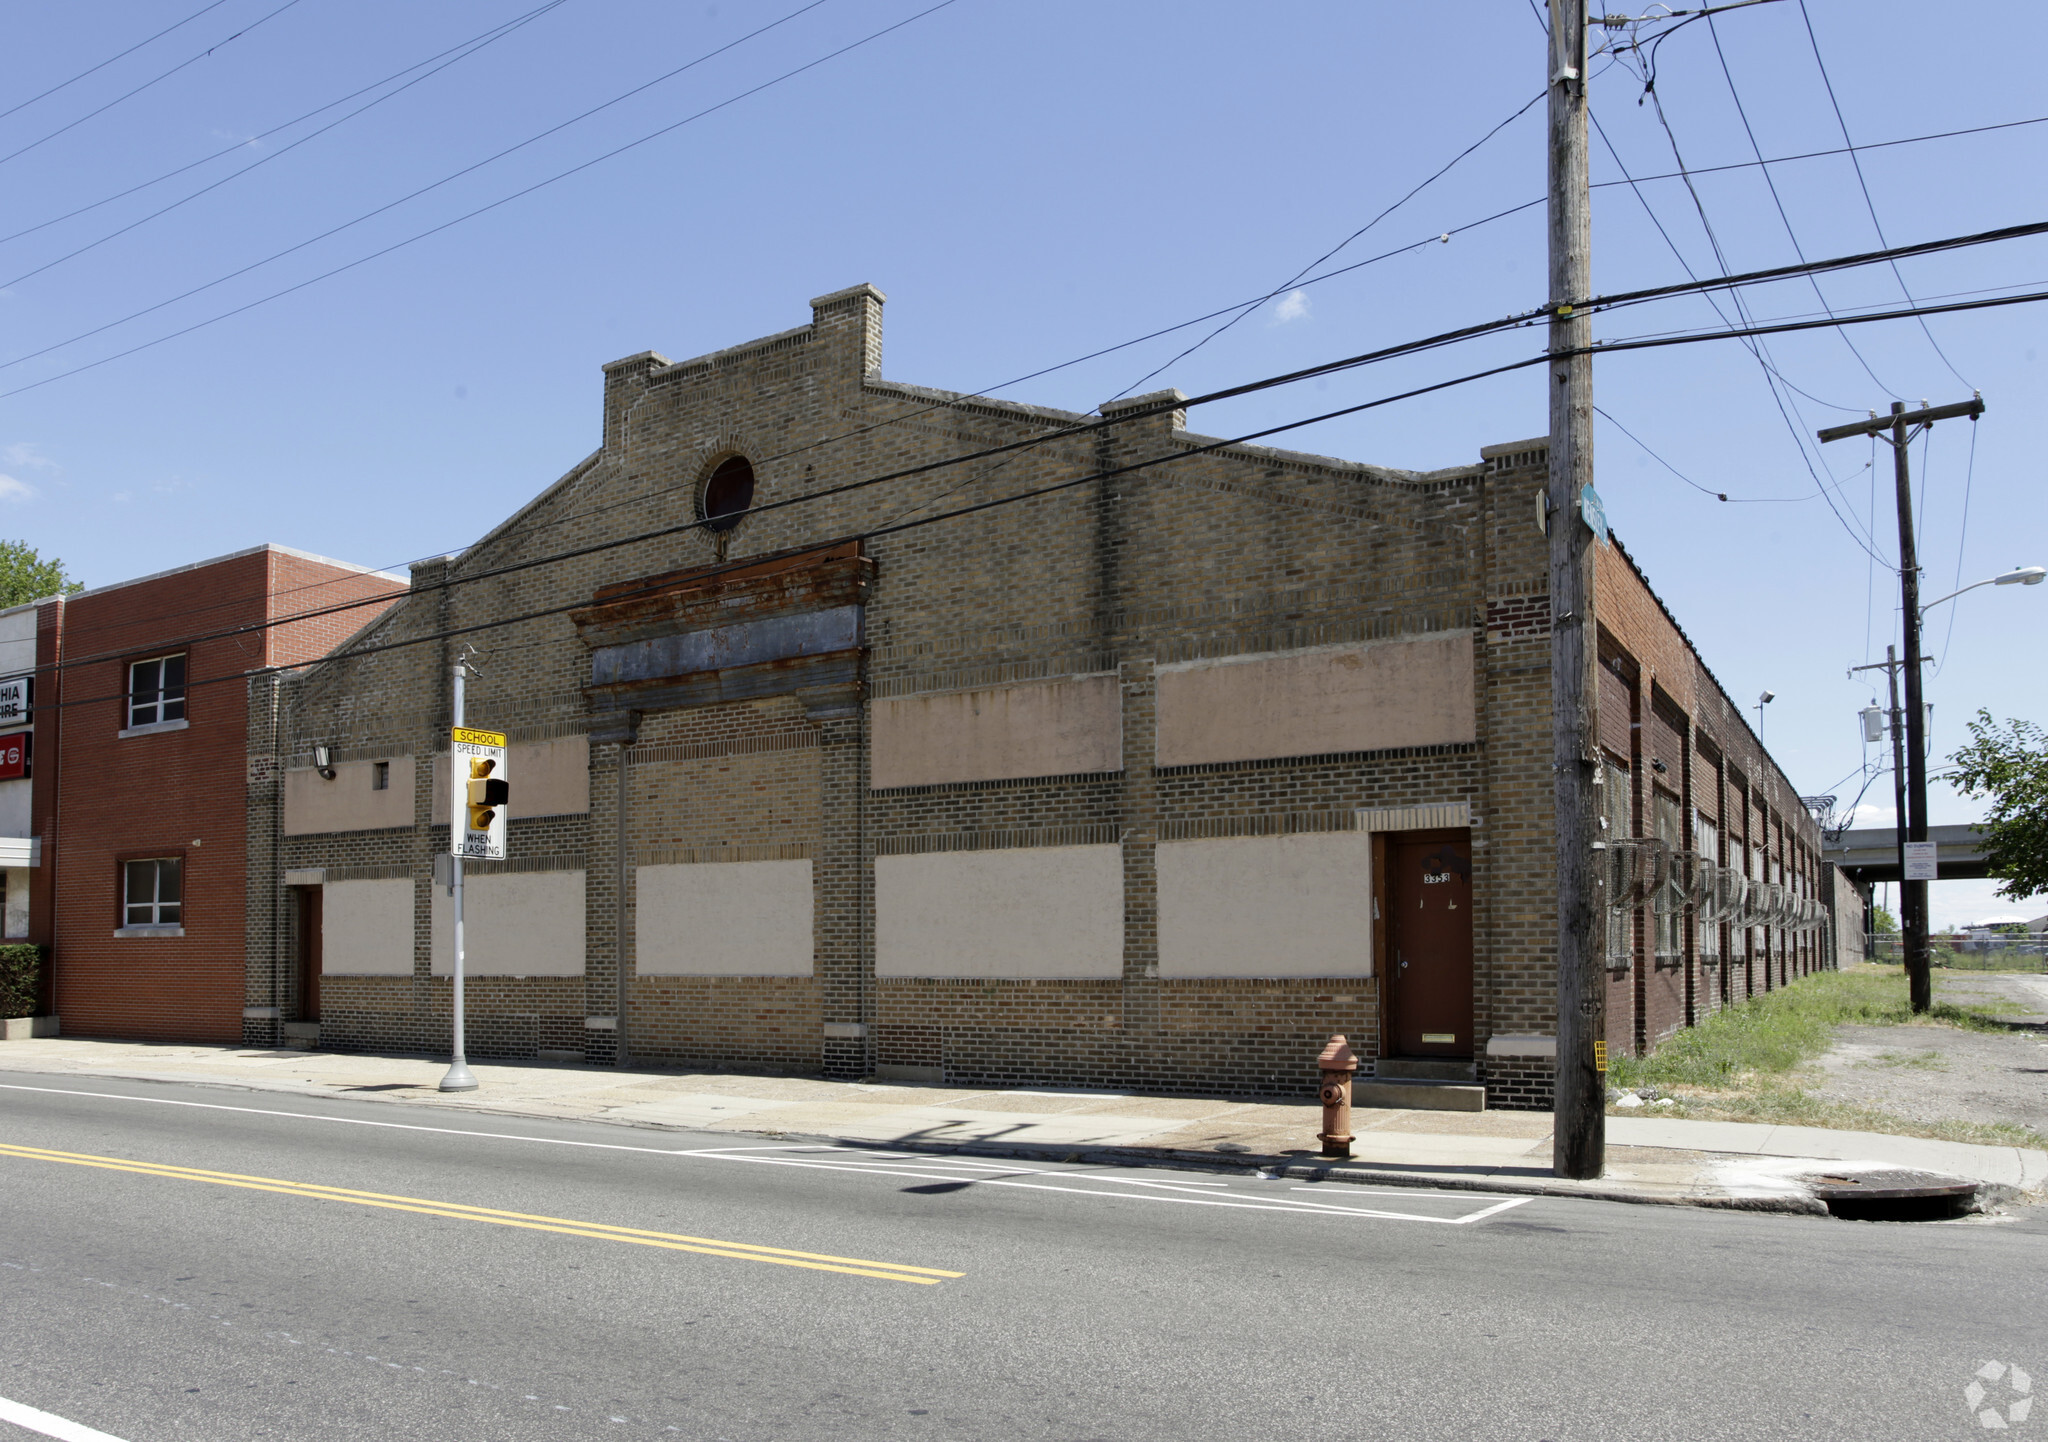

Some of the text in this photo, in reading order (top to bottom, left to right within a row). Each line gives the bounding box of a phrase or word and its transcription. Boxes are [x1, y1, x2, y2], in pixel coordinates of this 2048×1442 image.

[0, 702, 19, 719] IRE
[460, 731, 500, 746] SCHOOL
[457, 743, 502, 758] SPEED LIMIT
[466, 833, 492, 844] WHEN
[457, 843, 500, 856] FLASHING
[1425, 873, 1449, 883] 3353
